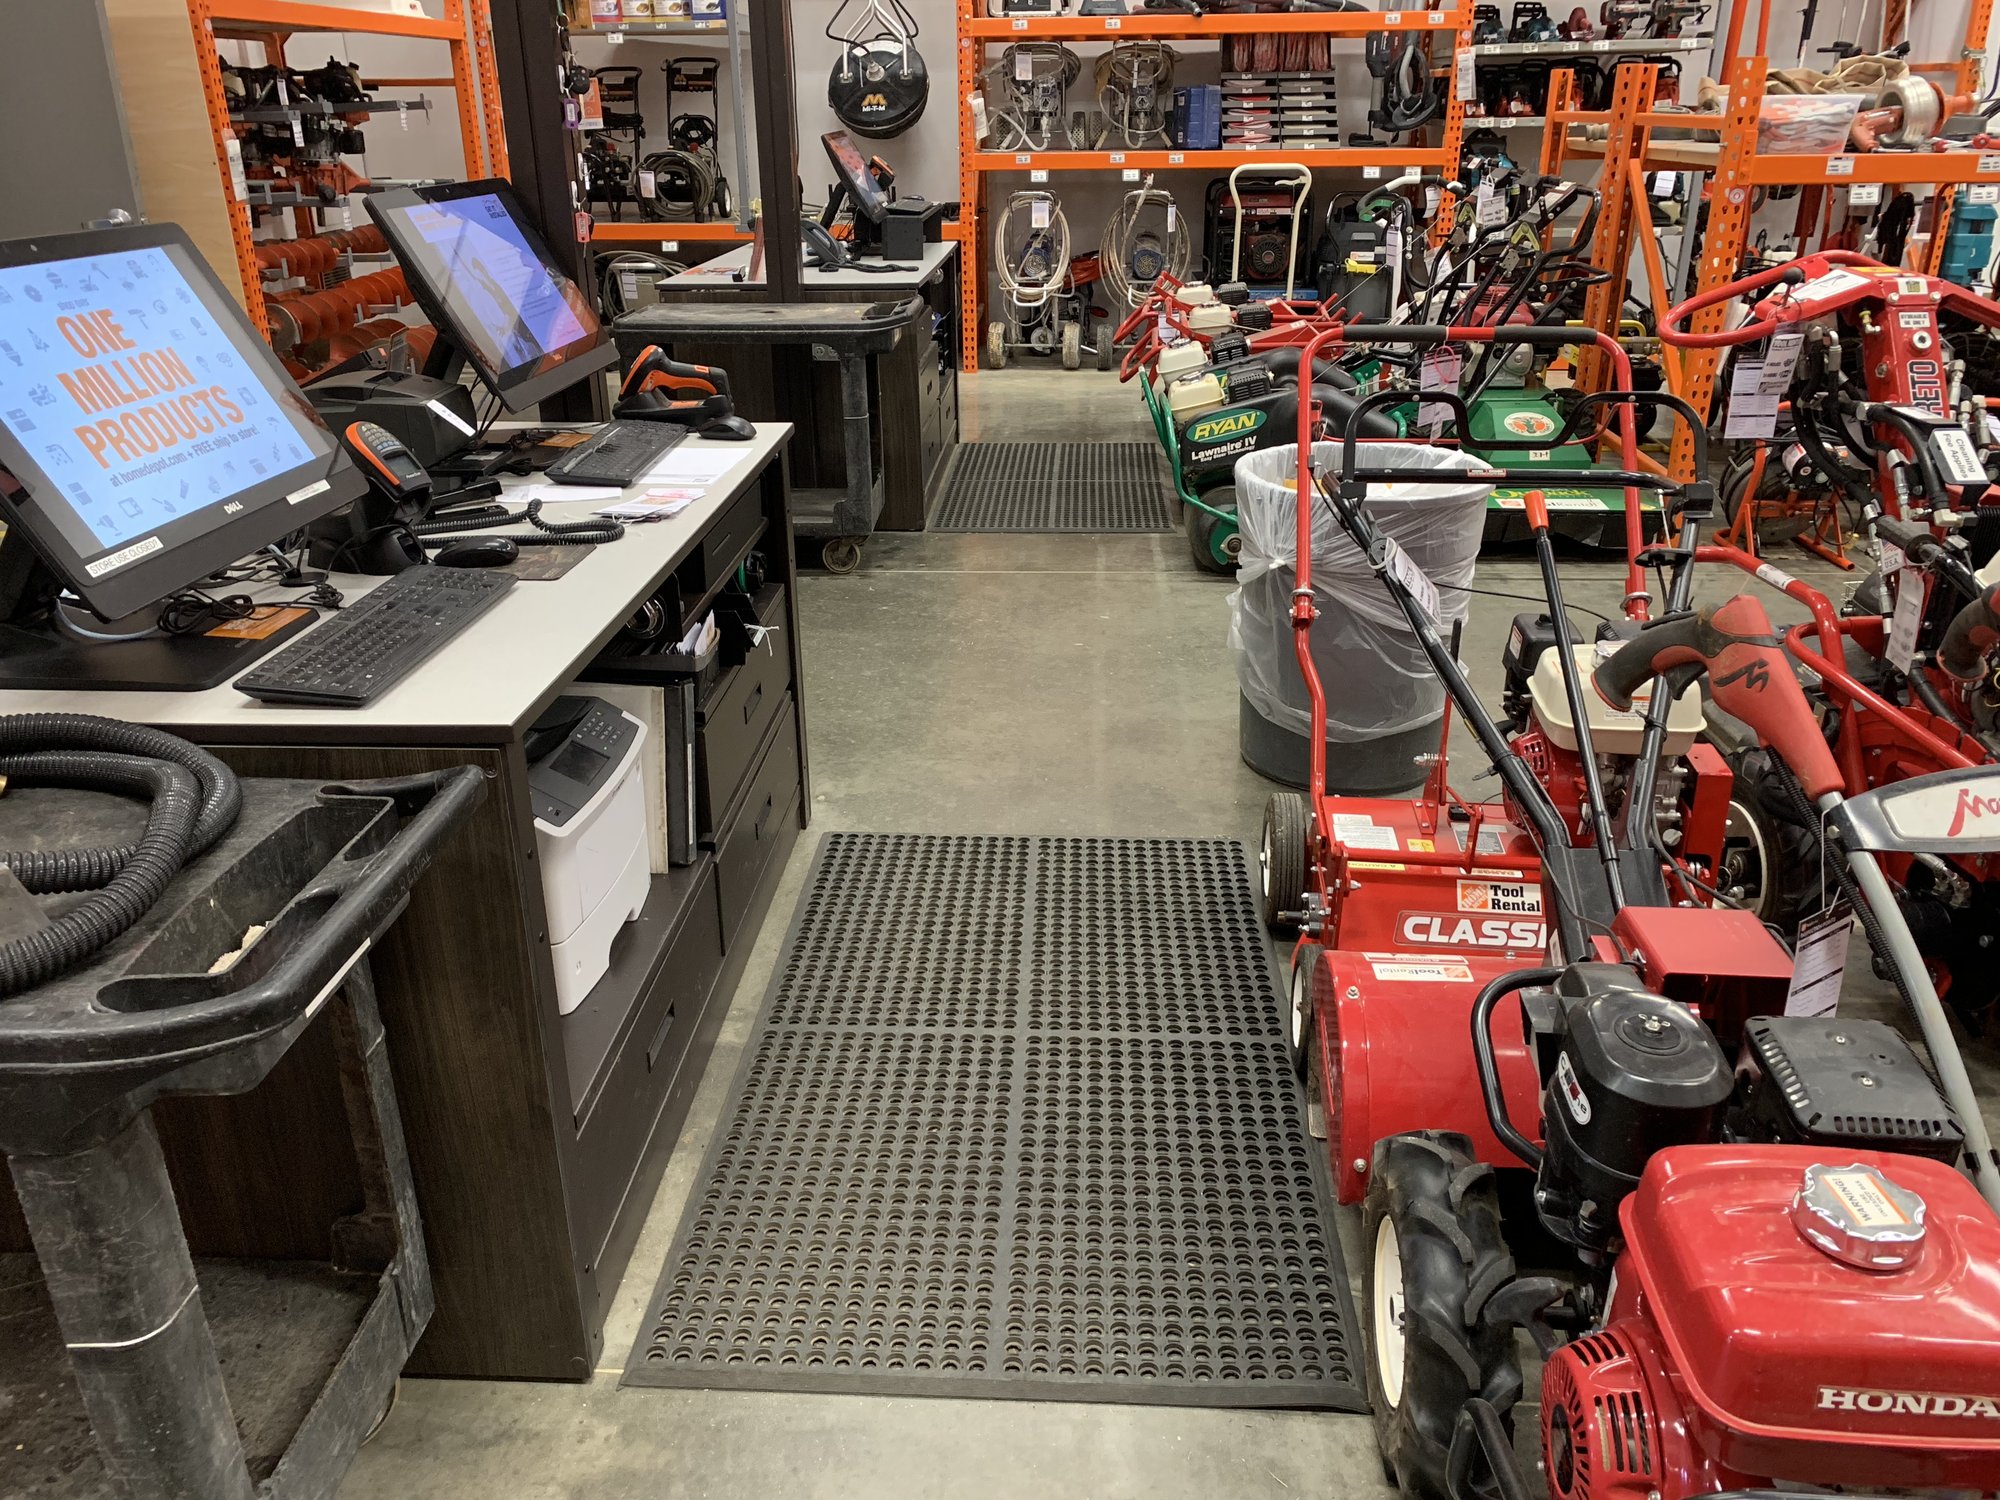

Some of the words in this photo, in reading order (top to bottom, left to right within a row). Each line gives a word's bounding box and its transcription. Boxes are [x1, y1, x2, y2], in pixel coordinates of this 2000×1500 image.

[56, 308, 138, 359] ONE
[56, 346, 197, 416] MILLION
[73, 385, 244, 470] PRODUCTS
[1194, 411, 1257, 440] RYAN
[1245, 436, 1257, 447] IV
[109, 475, 123, 487] at
[121, 451, 188, 484] homedepot.com
[191, 440, 215, 457] FREE
[213, 433, 233, 449] ship
[1943, 433, 1954, 448] Fee
[1951, 450, 1968, 479] Applies
[1956, 438, 1976, 473] Cleaning
[223, 500, 244, 515] DELL
[89, 558, 117, 575] STORE
[113, 551, 131, 564] USE
[1490, 884, 1525, 898] Tool
[1491, 898, 1541, 912] Rental
[1831, 1178, 1873, 1222] WARNING!
[1817, 1388, 2000, 1418] HONDA
